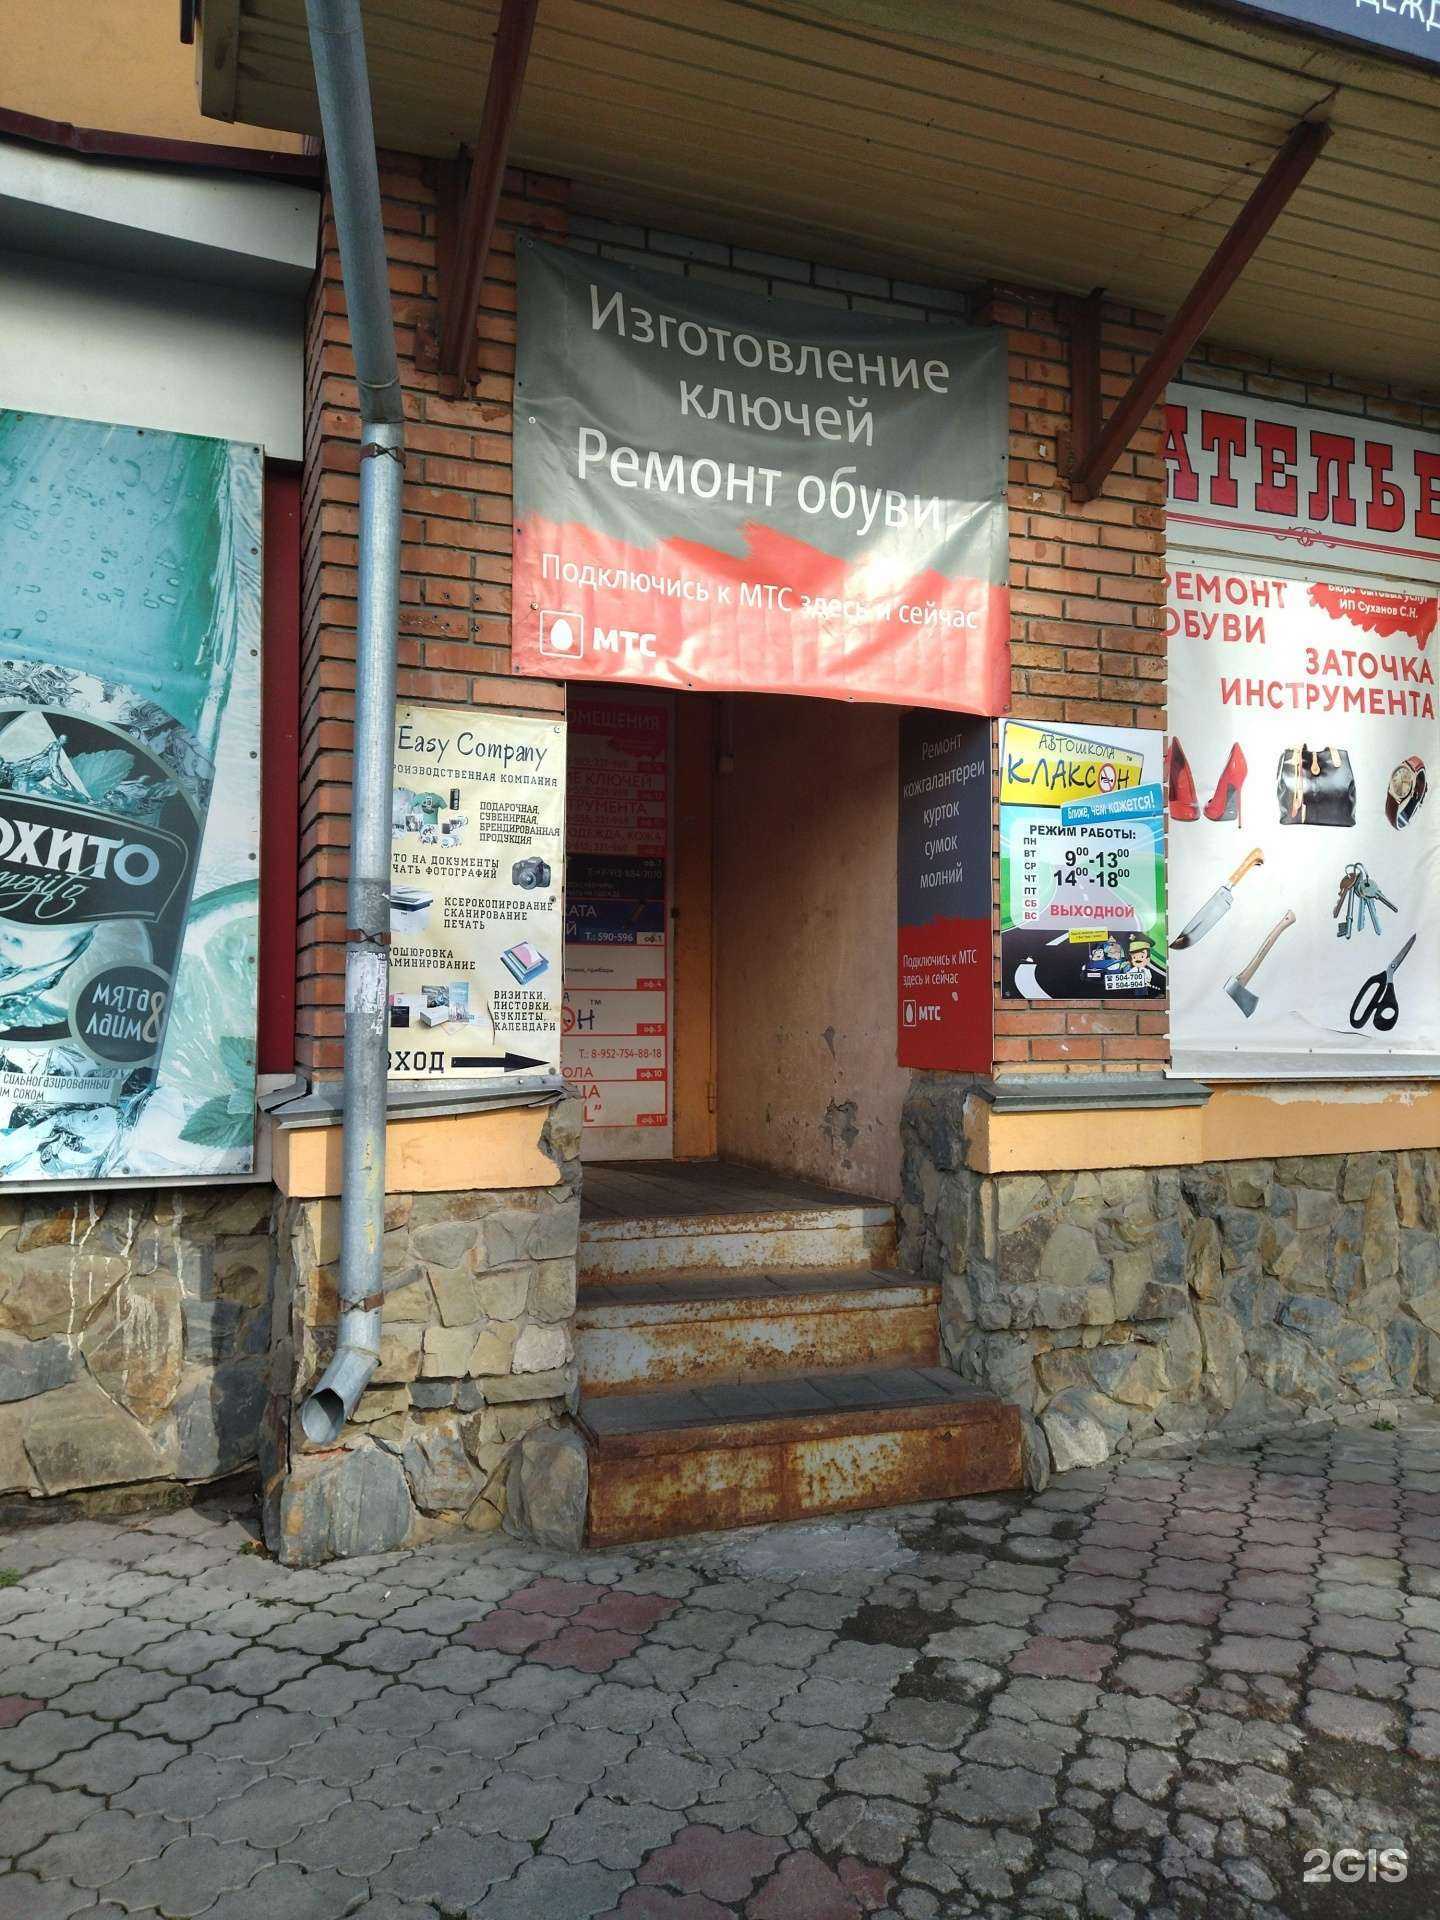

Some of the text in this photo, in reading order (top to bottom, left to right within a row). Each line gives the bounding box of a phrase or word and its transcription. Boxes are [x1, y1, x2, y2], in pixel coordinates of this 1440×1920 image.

[590, 284, 950, 394] Изготовление
[680, 380, 873, 447] ключей
[577, 426, 940, 536] Ремонт обуви
[542, 553, 709, 602] Подключись
[717, 587, 730, 603] к
[739, 582, 793, 612] МТС
[899, 601, 978, 630] сейчас
[1340, 599, 1355, 610] ИП
[1358, 601, 1397, 615] Суханов
[593, 628, 656, 657] МТС
[1305, 647, 1434, 685] ЗАТОЧКА
[1220, 677, 1435, 720] ИНСТРУМЕНТА
[398, 725, 547, 771] Easy Company
[922, 733, 962, 760] Ремонт
[1038, 734, 1116, 760] АВТОШКОЛА
[500, 774, 558, 788] КОМПАНИЯ
[903, 759, 985, 799] кожгалантереи
[479, 801, 540, 815] ПОДАРОЧНАЯ,
[923, 801, 960, 829] курток
[479, 812, 539, 825] СУВЕНИРНАЯ,
[479, 822, 561, 837] БРЕНДИРОВАННАЯ
[1029, 825, 1136, 840] РЕЖИМ РАБОТЫ:
[479, 833, 532, 845] ПРОДУКЦИЯ
[1023, 838, 1037, 846] ПН
[924, 834, 958, 860] сумок
[1024, 850, 1036, 858] ВТ
[412, 854, 427, 864] НА
[431, 855, 499, 868] ДОКУМЕНТЫ
[425, 866, 497, 879] ФОТОГРАФИЙ
[920, 862, 963, 889] молний
[1024, 875, 1037, 883] ЧТ
[1024, 887, 1037, 895] ПТ
[444, 897, 553, 911] КСЕРОКОПИРОВАНИЕ
[1024, 899, 1037, 908] СБ
[443, 908, 528, 921] СКАНИРОВАНИЕ
[1024, 912, 1038, 920] ВС
[1050, 904, 1135, 920] ВЫХОДНОЙ
[443, 919, 485, 930] ПЕЧАТЬ
[598, 931, 633, 942] 590-596
[903, 954, 950, 971] Подключись
[959, 949, 977, 965] МТС
[903, 974, 924, 988] здесь
[931, 970, 959, 986] сейчас
[494, 990, 545, 1000] ВИЗИТКИ,
[493, 1001, 552, 1011] ЛИСТОВКИ,
[919, 1005, 942, 1021] МТС
[494, 1012, 546, 1021] БУКЛЕТЫ,
[495, 1022, 556, 1032] КАЛЕНДАРИ
[591, 1048, 662, 1060] 8-952-754-88-18
